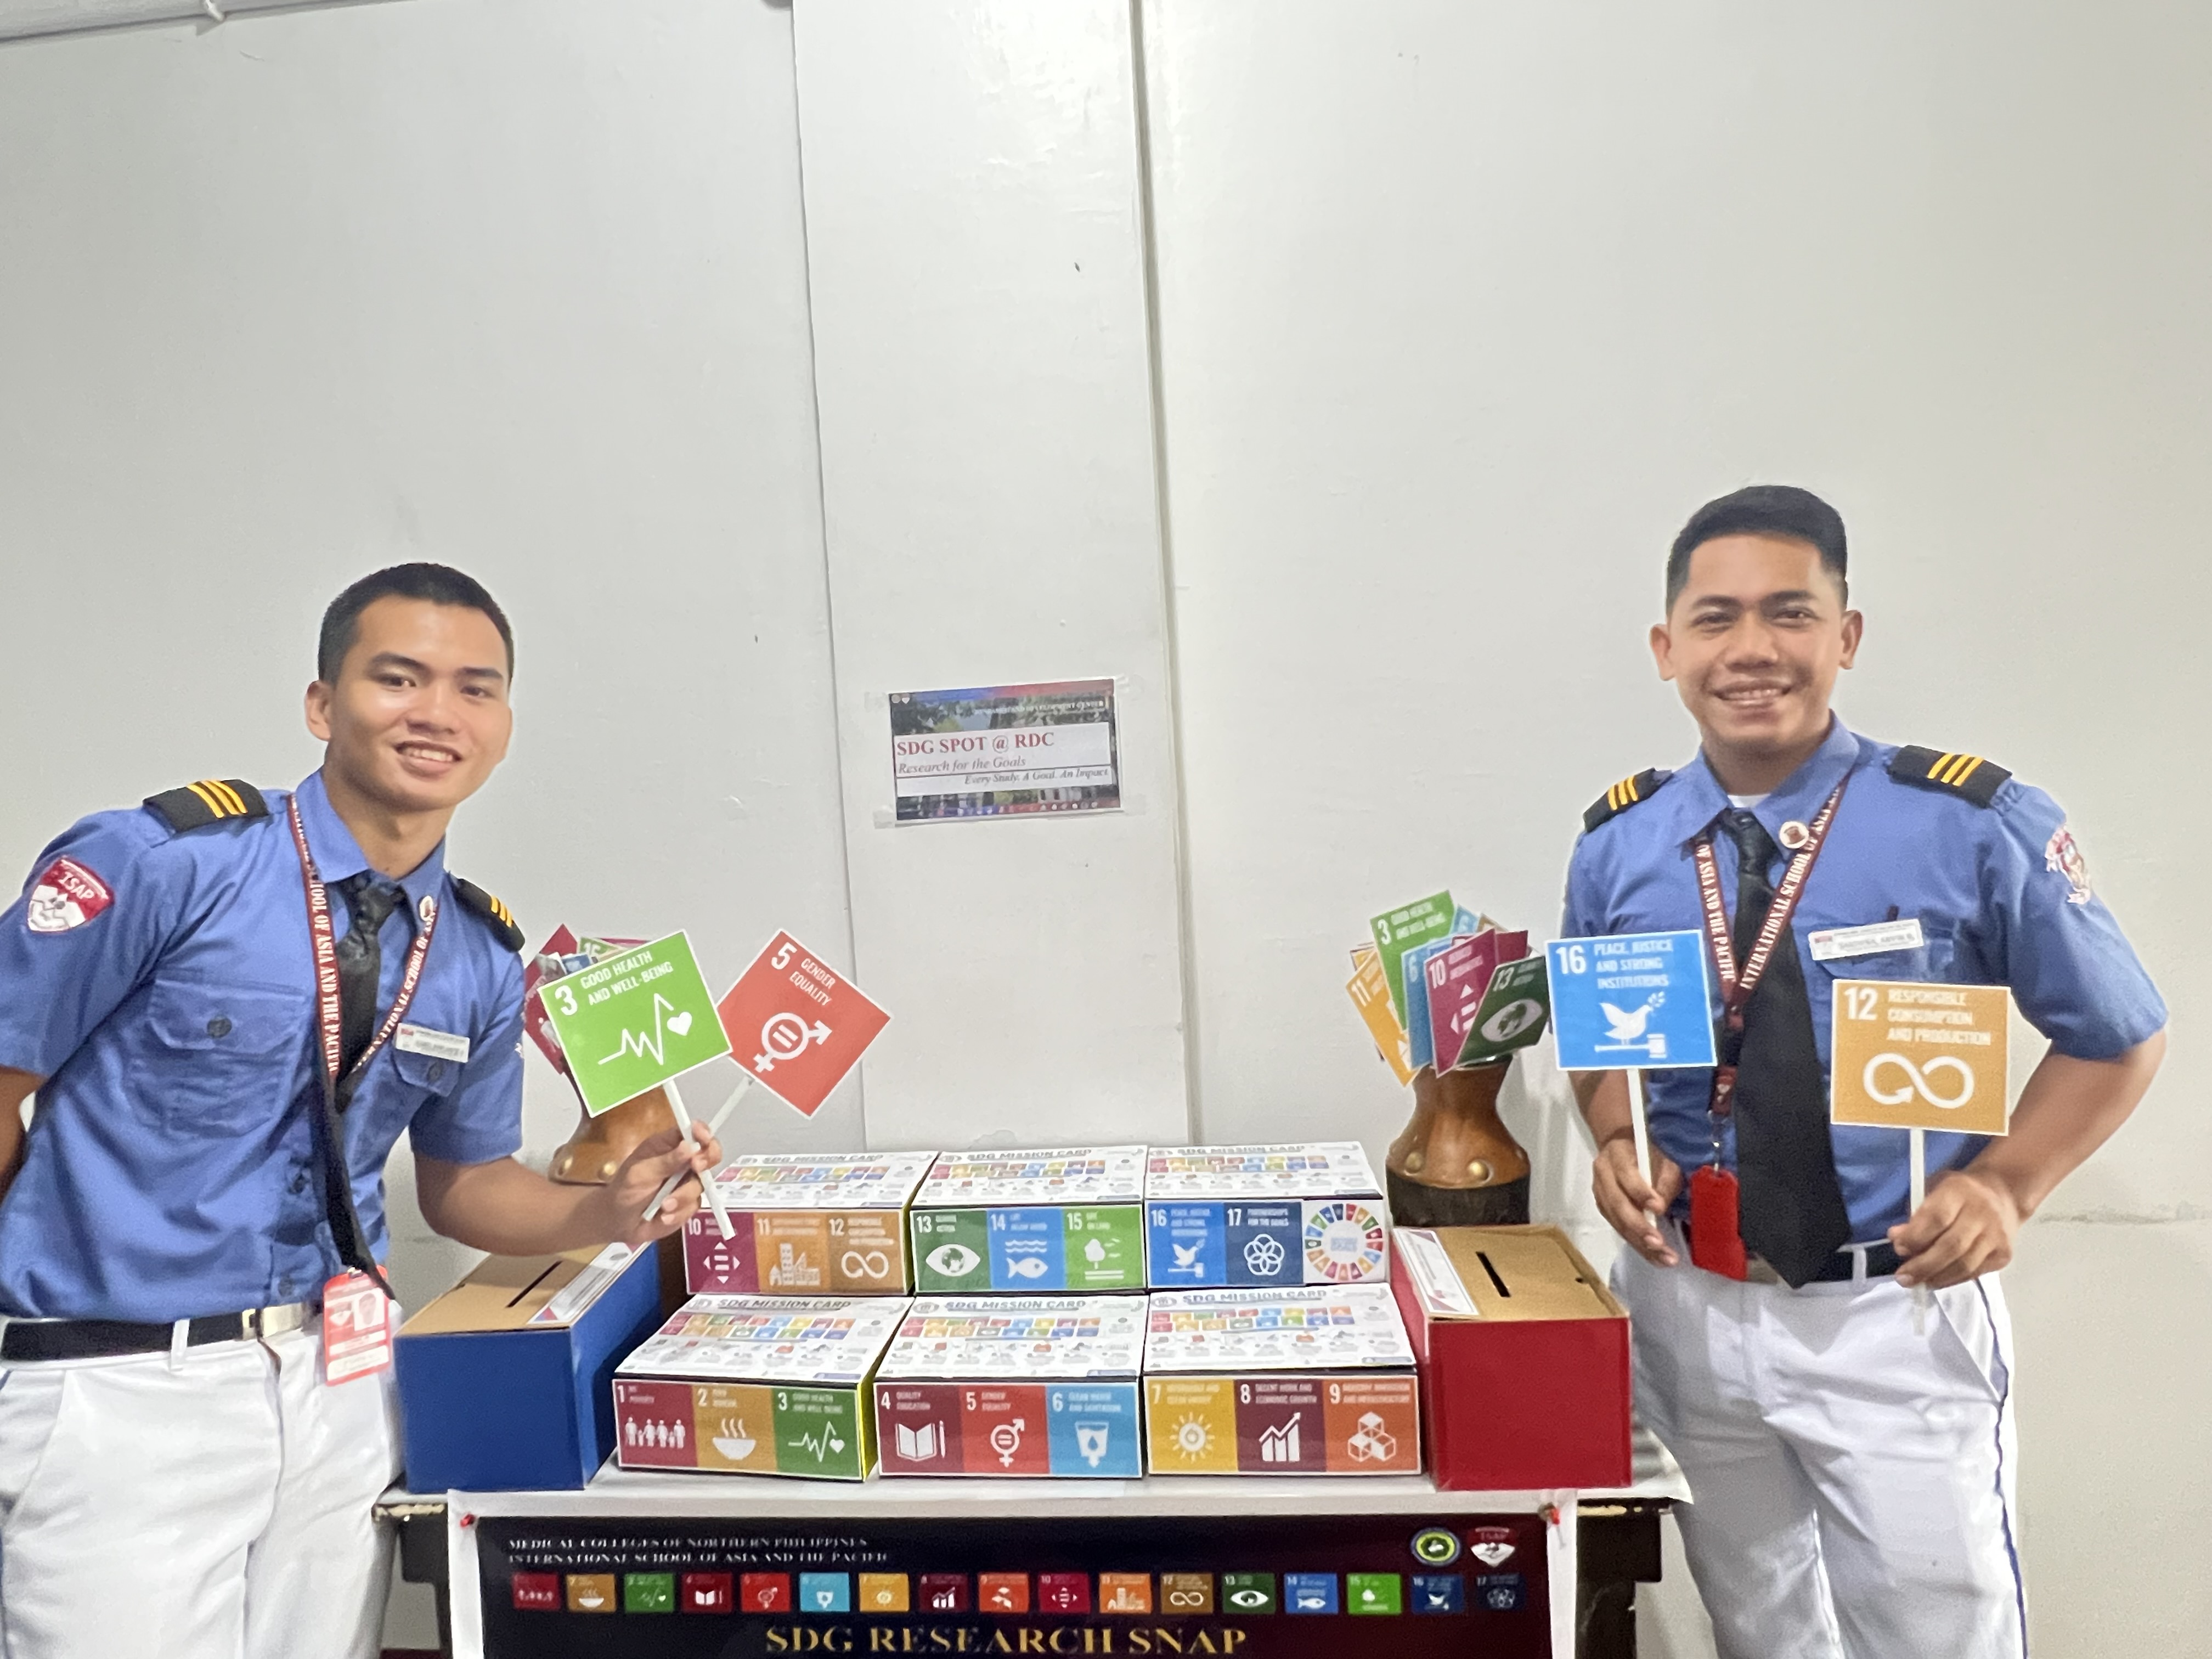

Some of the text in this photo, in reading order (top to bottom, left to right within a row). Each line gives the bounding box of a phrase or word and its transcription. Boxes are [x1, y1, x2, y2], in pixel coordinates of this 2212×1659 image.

[897, 732, 1054, 756] SDG SPOT @ RDC
[899, 755, 1026, 774] Research for the Goals
[964, 774, 991, 786] Every
[1023, 772, 1029, 781] A
[1059, 769, 1073, 778] An
[1076, 768, 1108, 780] Impact
[1699, 861, 1716, 887] ASIA
[58, 871, 94, 900] ISAP
[1703, 888, 1720, 910] AND
[313, 915, 331, 931] OF
[1378, 918, 1392, 945] 3
[1708, 911, 1725, 935] THE
[315, 934, 334, 964] ASIA
[415, 935, 429, 950] OF
[771, 941, 797, 970] 5
[1555, 945, 1586, 974] 16
[1596, 957, 1663, 973] AND STRONG
[580, 950, 653, 989] GOOD HEALTH
[800, 958, 836, 989] GENDER
[1408, 954, 1419, 983] 6
[1429, 958, 1446, 989] 10
[319, 966, 337, 993] AND
[588, 961, 674, 1006] AND WELL-BEING
[789, 970, 832, 1006] EQUALITY
[1493, 967, 1515, 992] 13
[1598, 974, 1669, 989] INSTITUTIONS
[555, 985, 578, 1015] 3
[1351, 979, 1372, 1008] 11
[1844, 987, 1878, 1020] 12
[322, 994, 339, 1023] THE
[687, 1218, 702, 1235] 10
[757, 1218, 770, 1235] 11
[828, 1218, 845, 1236] 12
[916, 1215, 932, 1233] 13
[990, 1214, 1006, 1231] 14
[1066, 1212, 1083, 1230] 15
[1150, 1209, 1167, 1227] 16
[1227, 1208, 1242, 1227] 17
[718, 1298, 852, 1310] SDG MISSION CARD
[945, 1300, 1086, 1310] SDG MISSION CARD
[1183, 1290, 1327, 1304] SDG MISSION CARD
[617, 1385, 625, 1403] 1
[697, 1388, 708, 1407] 2
[778, 1391, 788, 1411] 3
[881, 1391, 891, 1410] 4
[966, 1391, 977, 1411] 5
[1052, 1392, 1063, 1412] 6
[1152, 1384, 1161, 1404] 7
[1240, 1384, 1251, 1404] 8
[1329, 1383, 1341, 1404] 9
[509, 1537, 868, 1549] MEDICAL COLLEGES OF NORTHERN PHILIPPINES
[509, 1551, 888, 1564] INTERNATIONAL SCHOOL OF ASIA AND THE PACIFIC
[1041, 1575, 1051, 1584] 10
[1101, 1575, 1110, 1584] 11
[1162, 1575, 1173, 1585] 12
[1224, 1575, 1235, 1585] 13
[766, 1626, 1246, 1654] SDG RESEARCH SNAP
